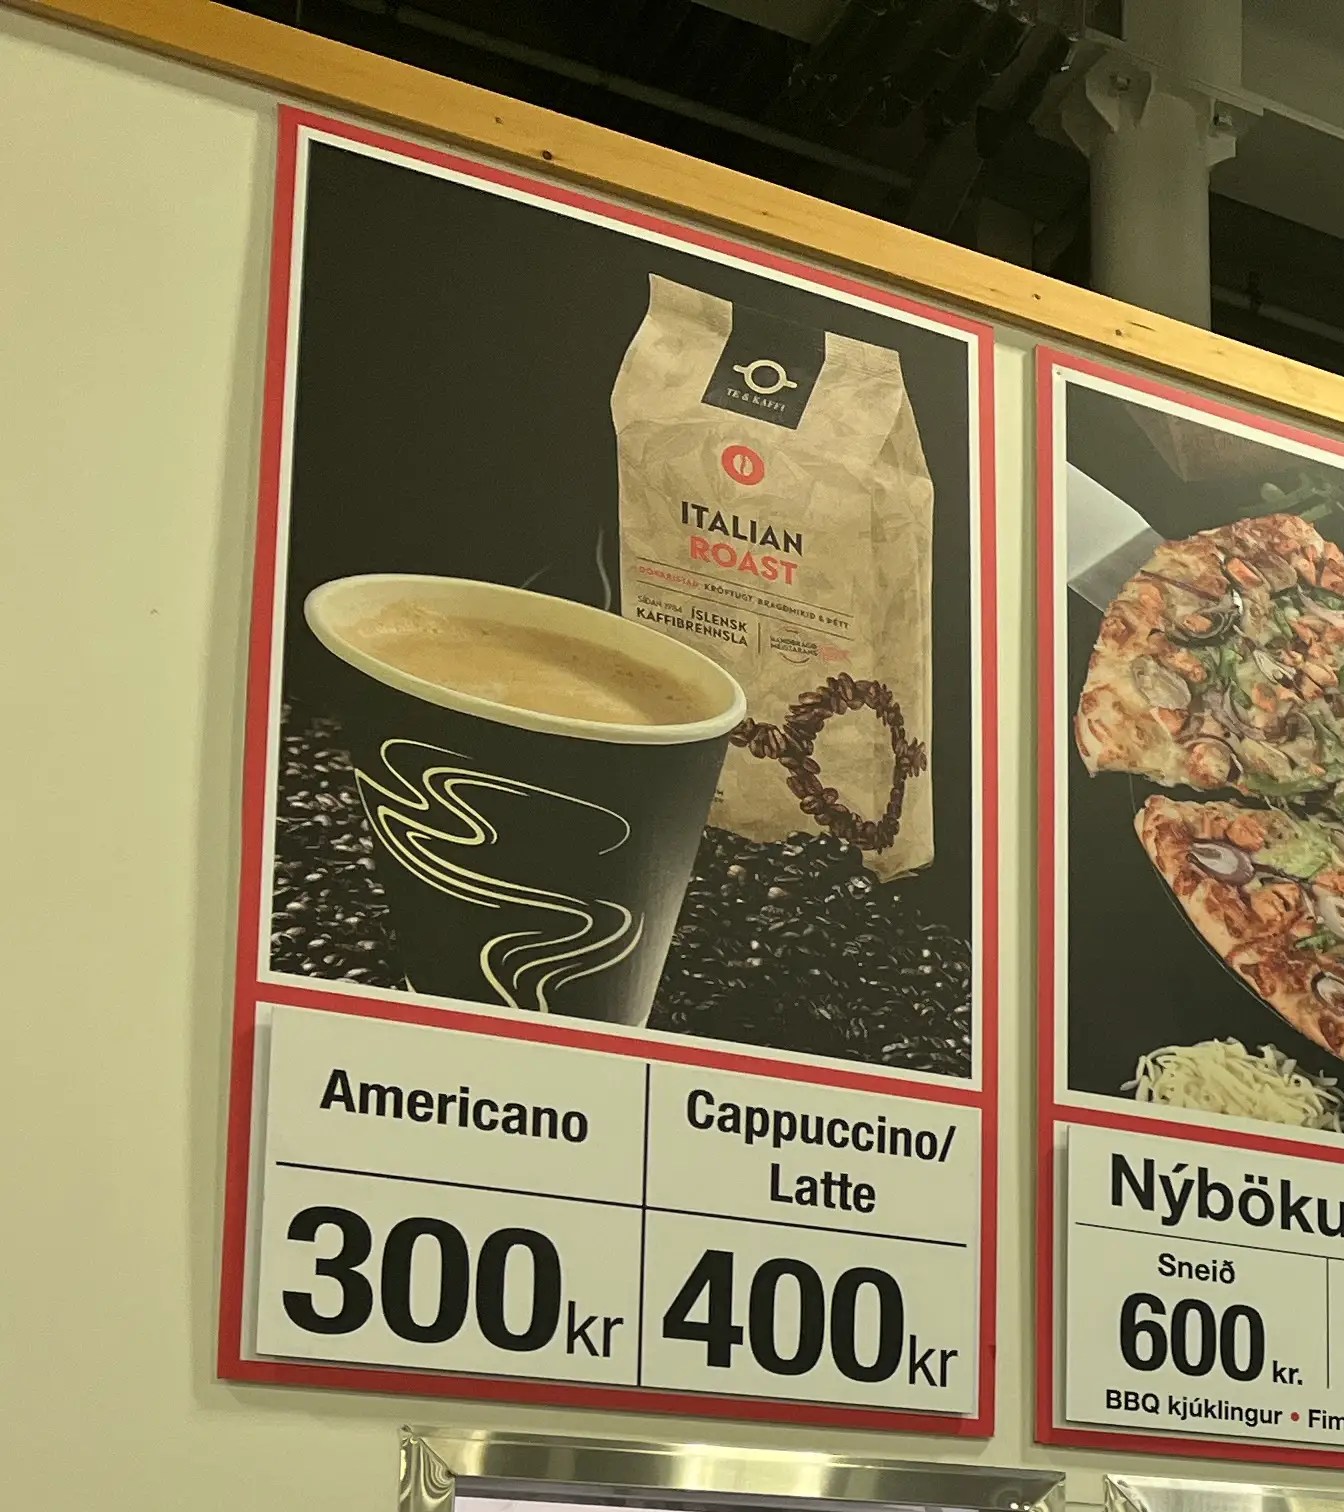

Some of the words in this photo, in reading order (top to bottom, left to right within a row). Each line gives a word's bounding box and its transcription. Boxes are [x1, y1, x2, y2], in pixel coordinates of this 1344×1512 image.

[681, 501, 803, 556] ITALIAN
[690, 535, 798, 586] ROAST
[636, 607, 748, 647] KAFFIBRENNSLA
[691, 606, 748, 633] ÍSLENSK
[319, 1069, 588, 1143] Americano
[687, 1089, 956, 1162] Cappuccino/
[770, 1163, 875, 1213] Latte
[1158, 1253, 1235, 1284] Sneið
[1106, 1389, 1160, 1415] BBQ
[1168, 1395, 1283, 1427] kjúklingur
